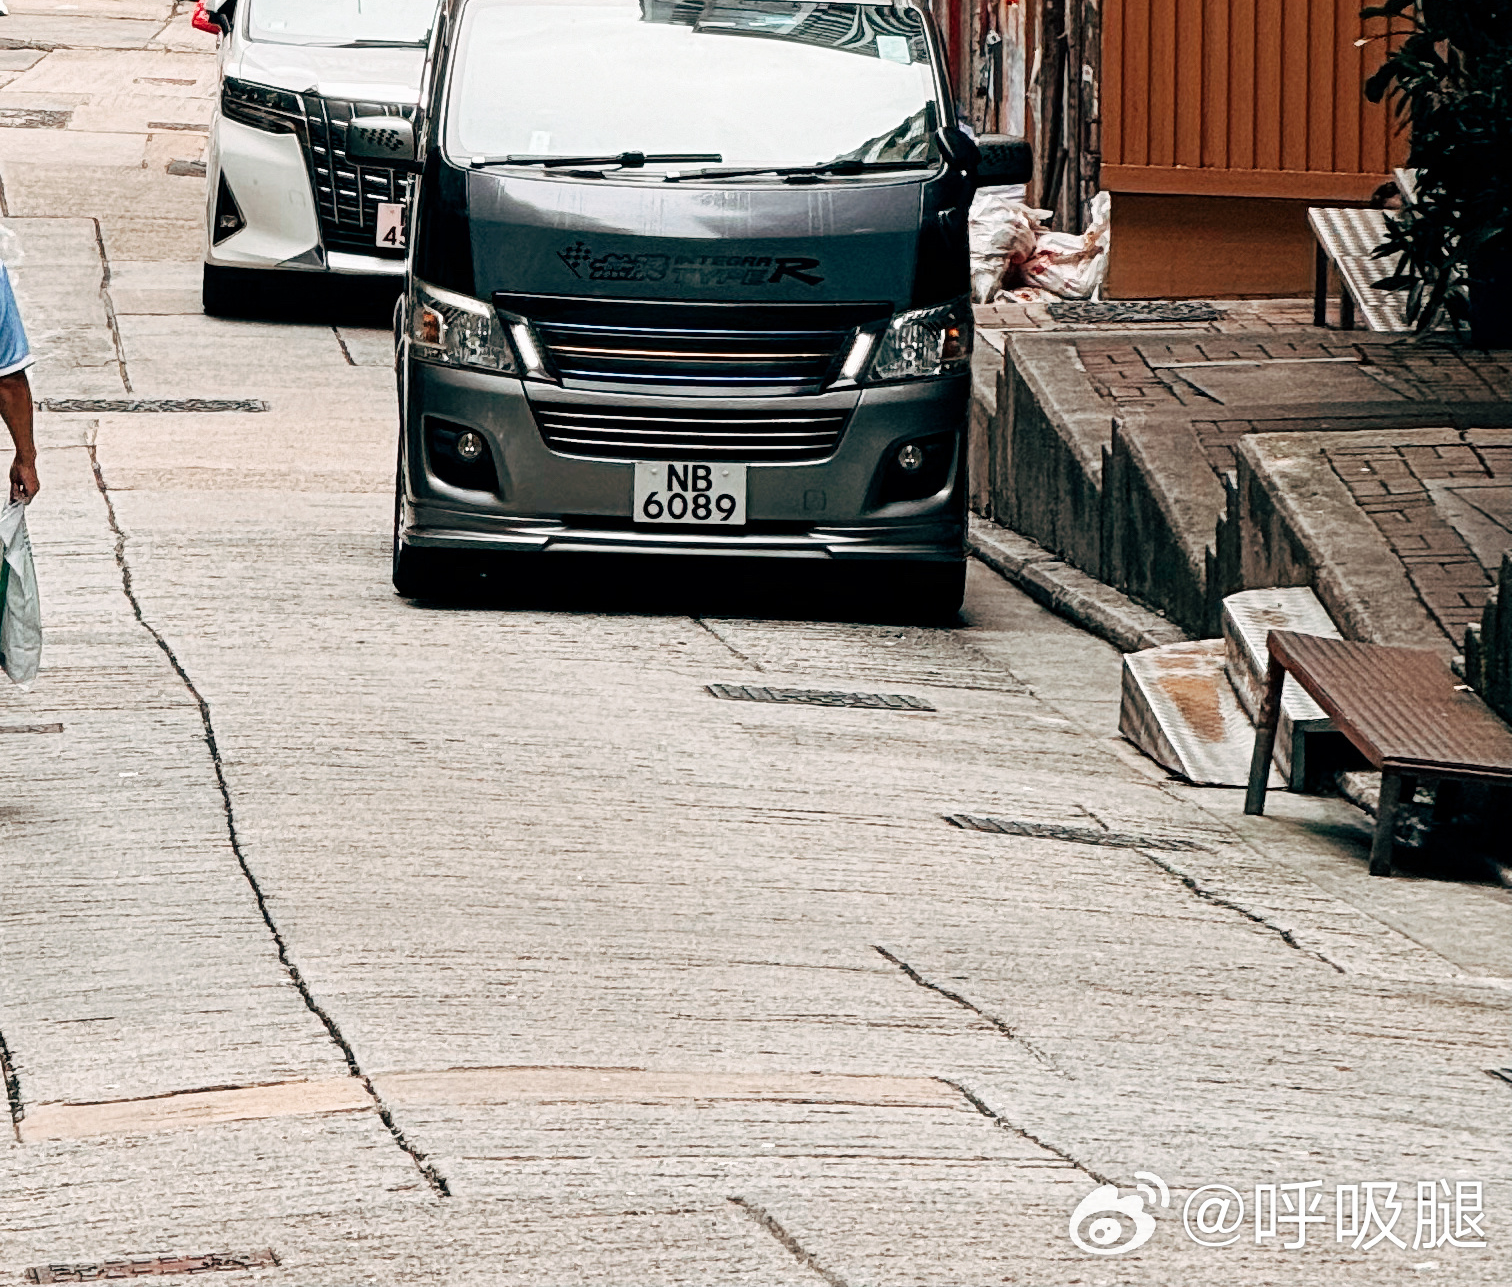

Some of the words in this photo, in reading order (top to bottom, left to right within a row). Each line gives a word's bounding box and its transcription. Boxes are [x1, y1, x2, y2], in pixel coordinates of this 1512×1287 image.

[768, 257, 825, 286] R
[667, 463, 713, 493] NB
[643, 491, 737, 521] 6089
